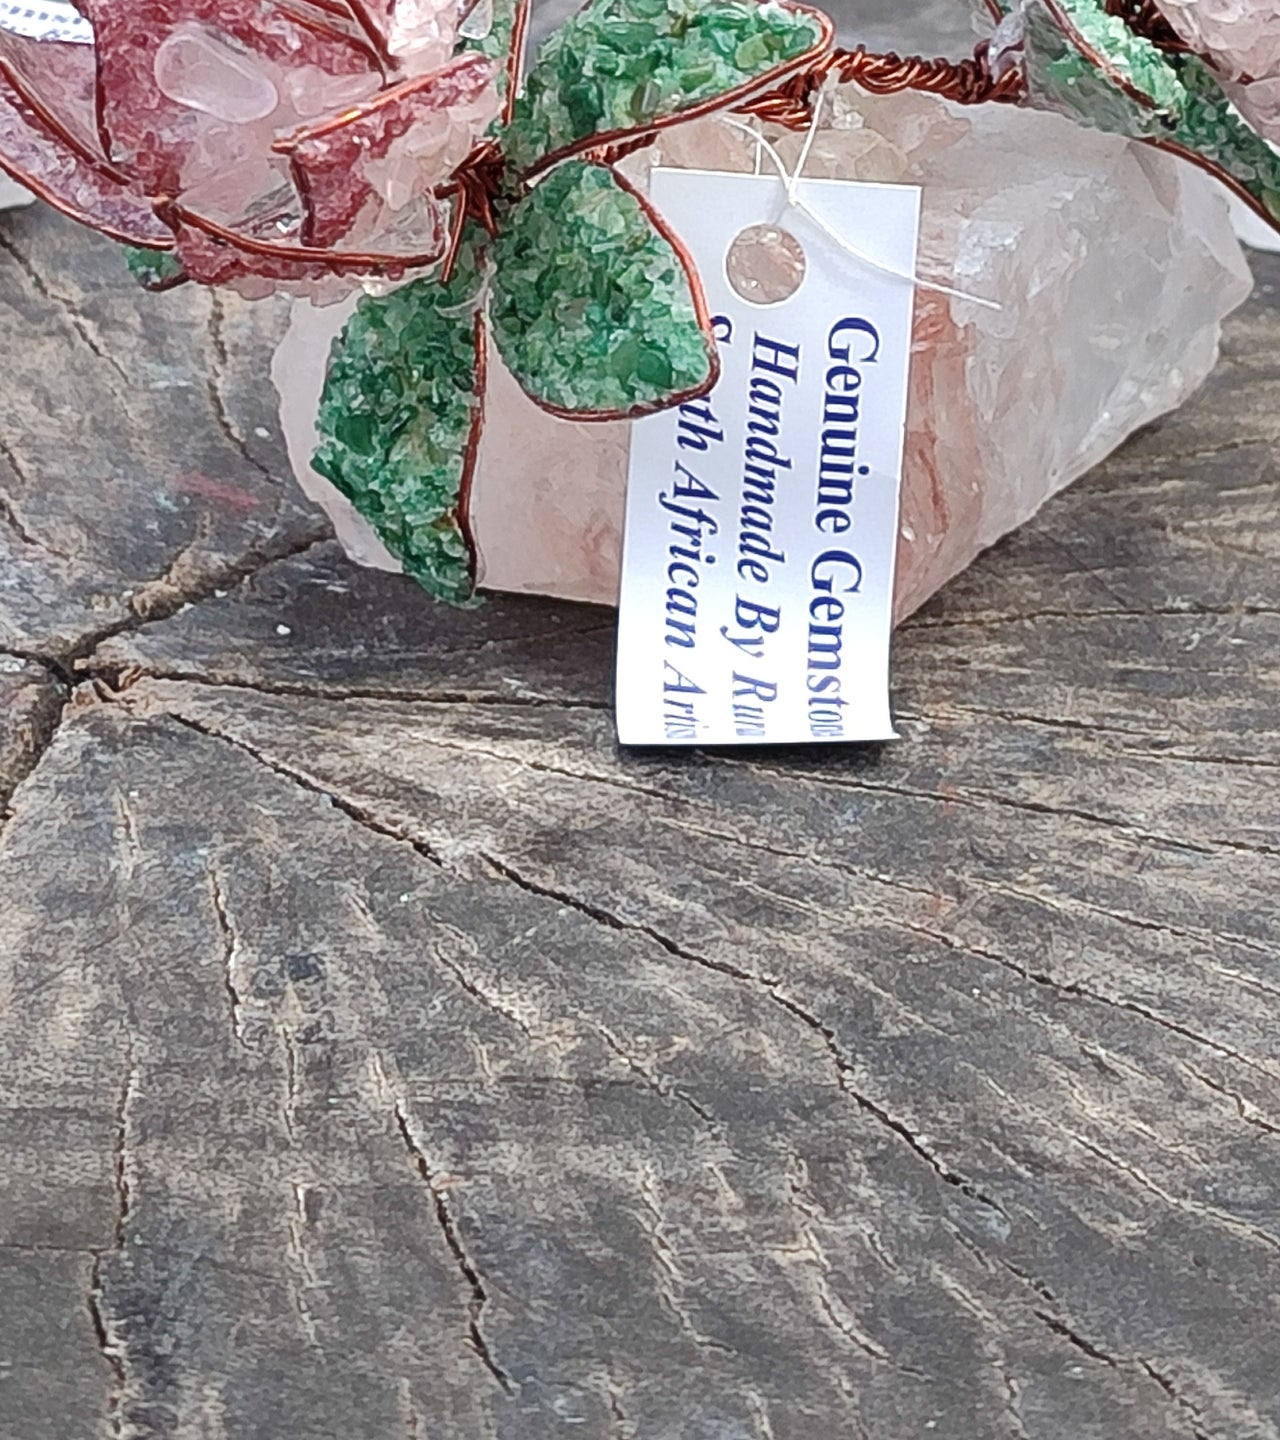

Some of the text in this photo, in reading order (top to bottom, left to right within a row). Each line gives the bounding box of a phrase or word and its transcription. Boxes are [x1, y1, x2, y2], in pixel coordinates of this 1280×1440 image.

[736, 330, 801, 585] Handmade
[814, 316, 880, 534] Genuine
[658, 460, 721, 648] African
[720, 593, 782, 658] By
